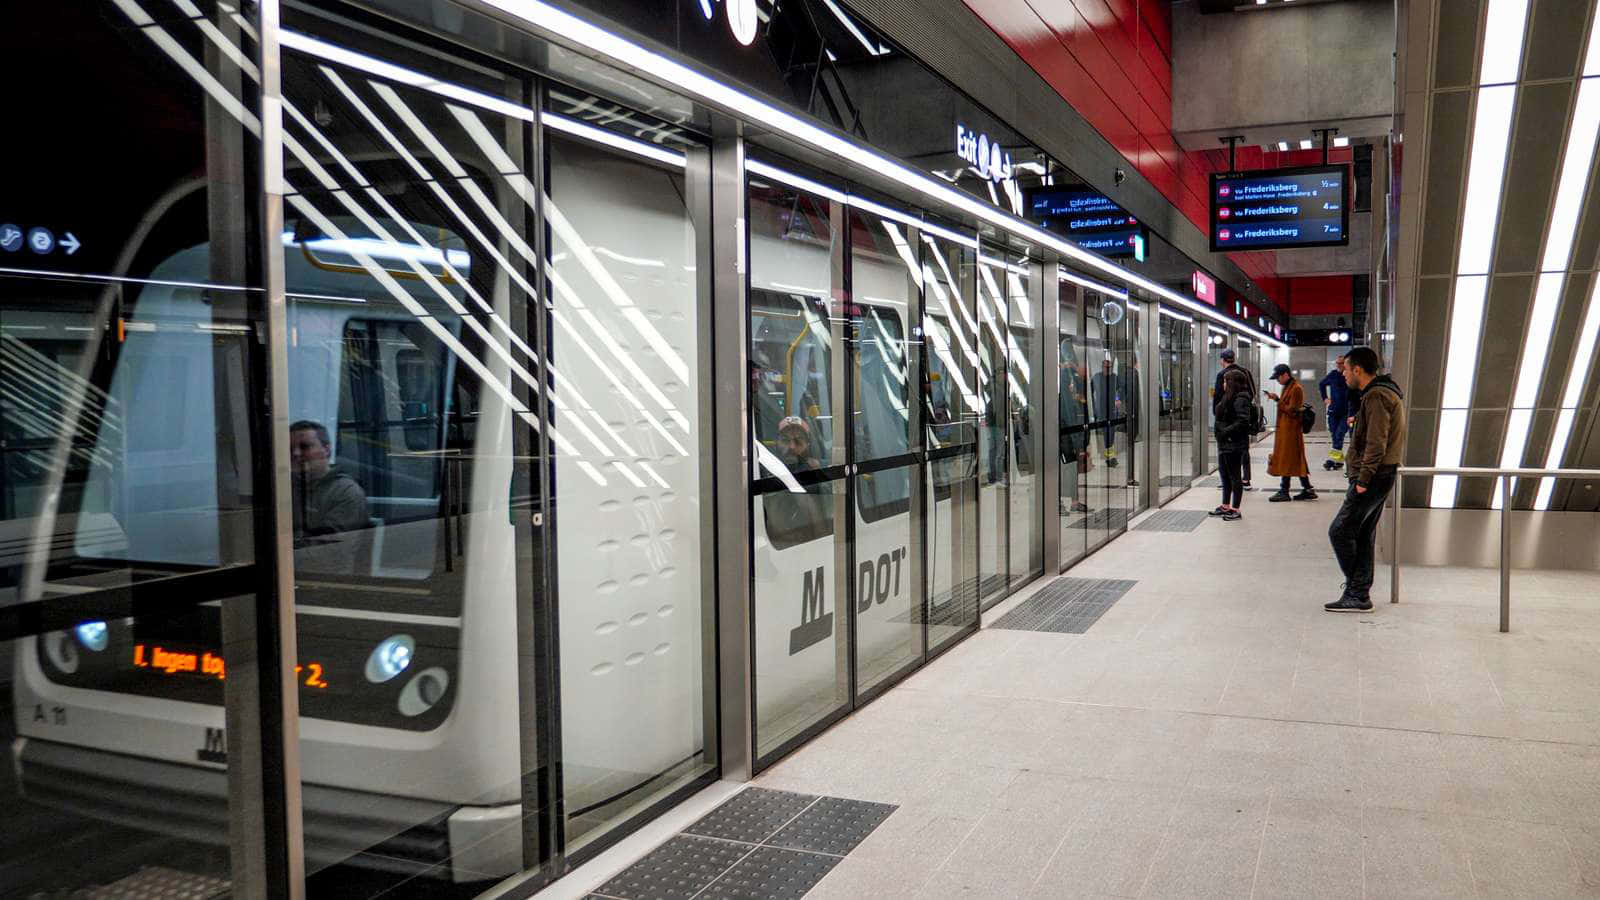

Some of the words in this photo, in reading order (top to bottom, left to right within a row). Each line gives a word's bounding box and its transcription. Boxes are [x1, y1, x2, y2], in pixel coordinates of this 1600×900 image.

[957, 124, 977, 165] Exit
[1244, 184, 1298, 193] Frederiksberg
[1244, 206, 1298, 216] Frederiksberg
[1244, 229, 1298, 238] Frederiksberg
[33, 703, 48, 723] A
